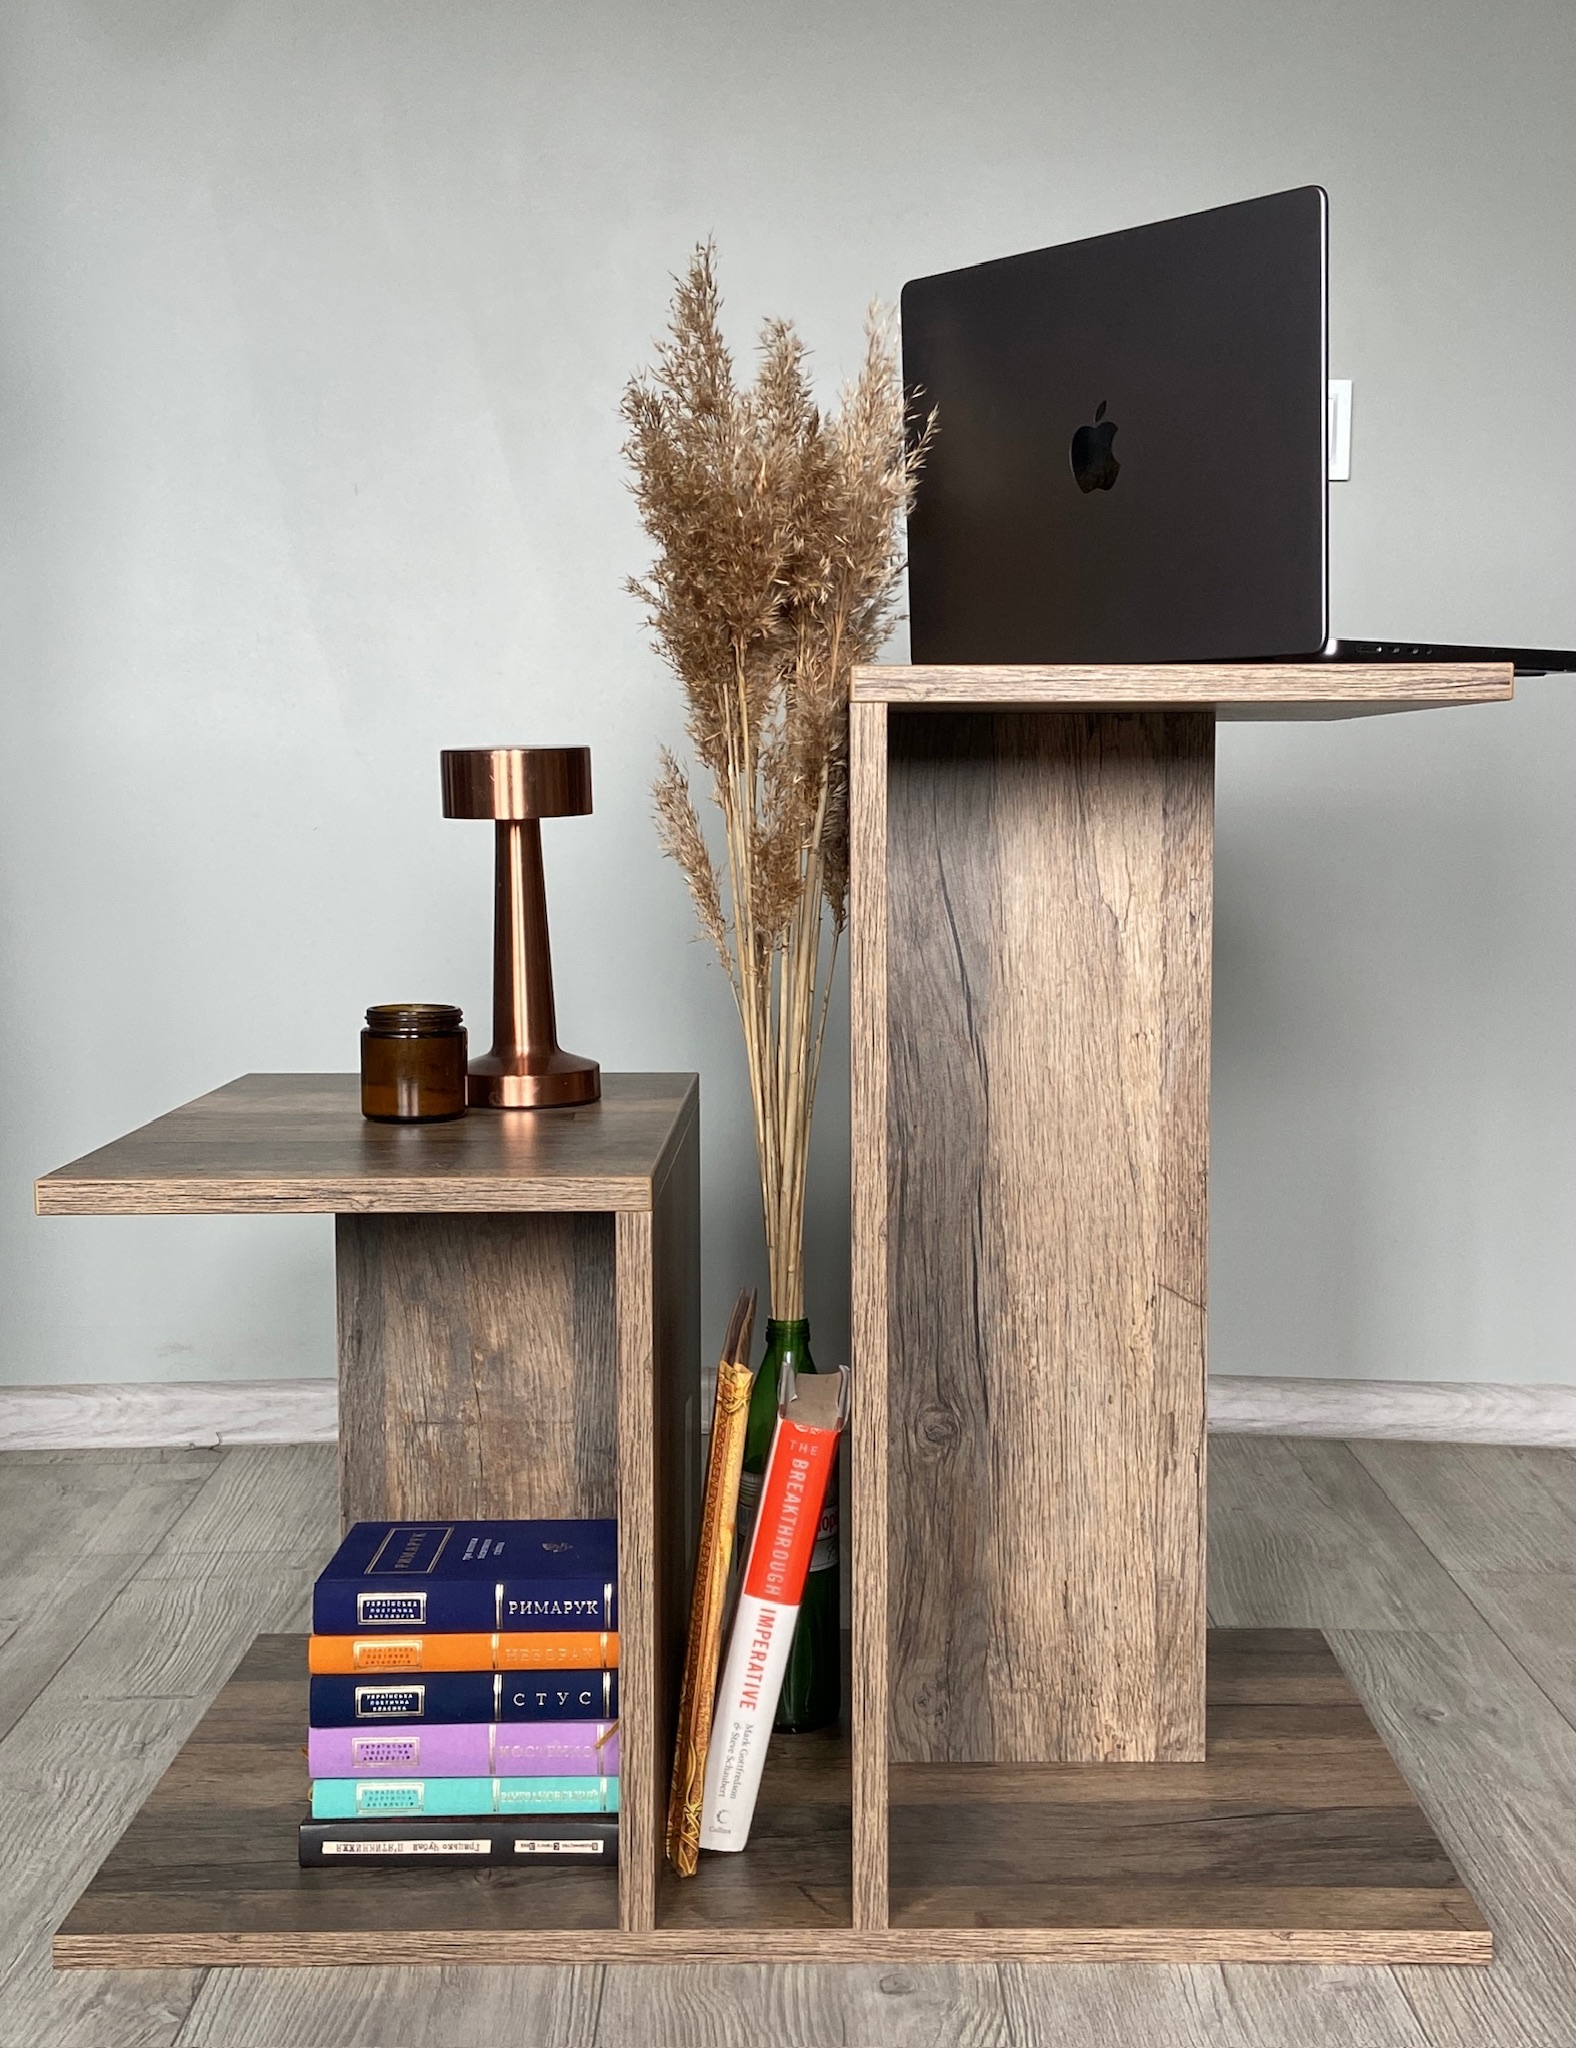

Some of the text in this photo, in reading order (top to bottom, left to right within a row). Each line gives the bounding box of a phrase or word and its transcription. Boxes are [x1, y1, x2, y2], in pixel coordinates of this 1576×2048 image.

[789, 1439, 820, 1457] THE
[764, 1458, 809, 1596] BREAKTHROUGH
[508, 1600, 598, 1615] РИМАРУК
[505, 1647, 594, 1662] НЕБОРАК
[739, 1607, 776, 1712] IMPERATIVE
[513, 1691, 592, 1706] СТУС
[728, 1731, 740, 1753] Steve
[729, 1723, 754, 1800] Mark Gottfredson
[718, 1753, 736, 1798] Schaubert
[413, 1842, 440, 1852] Чубай
[442, 1842, 480, 1852] Грицько
